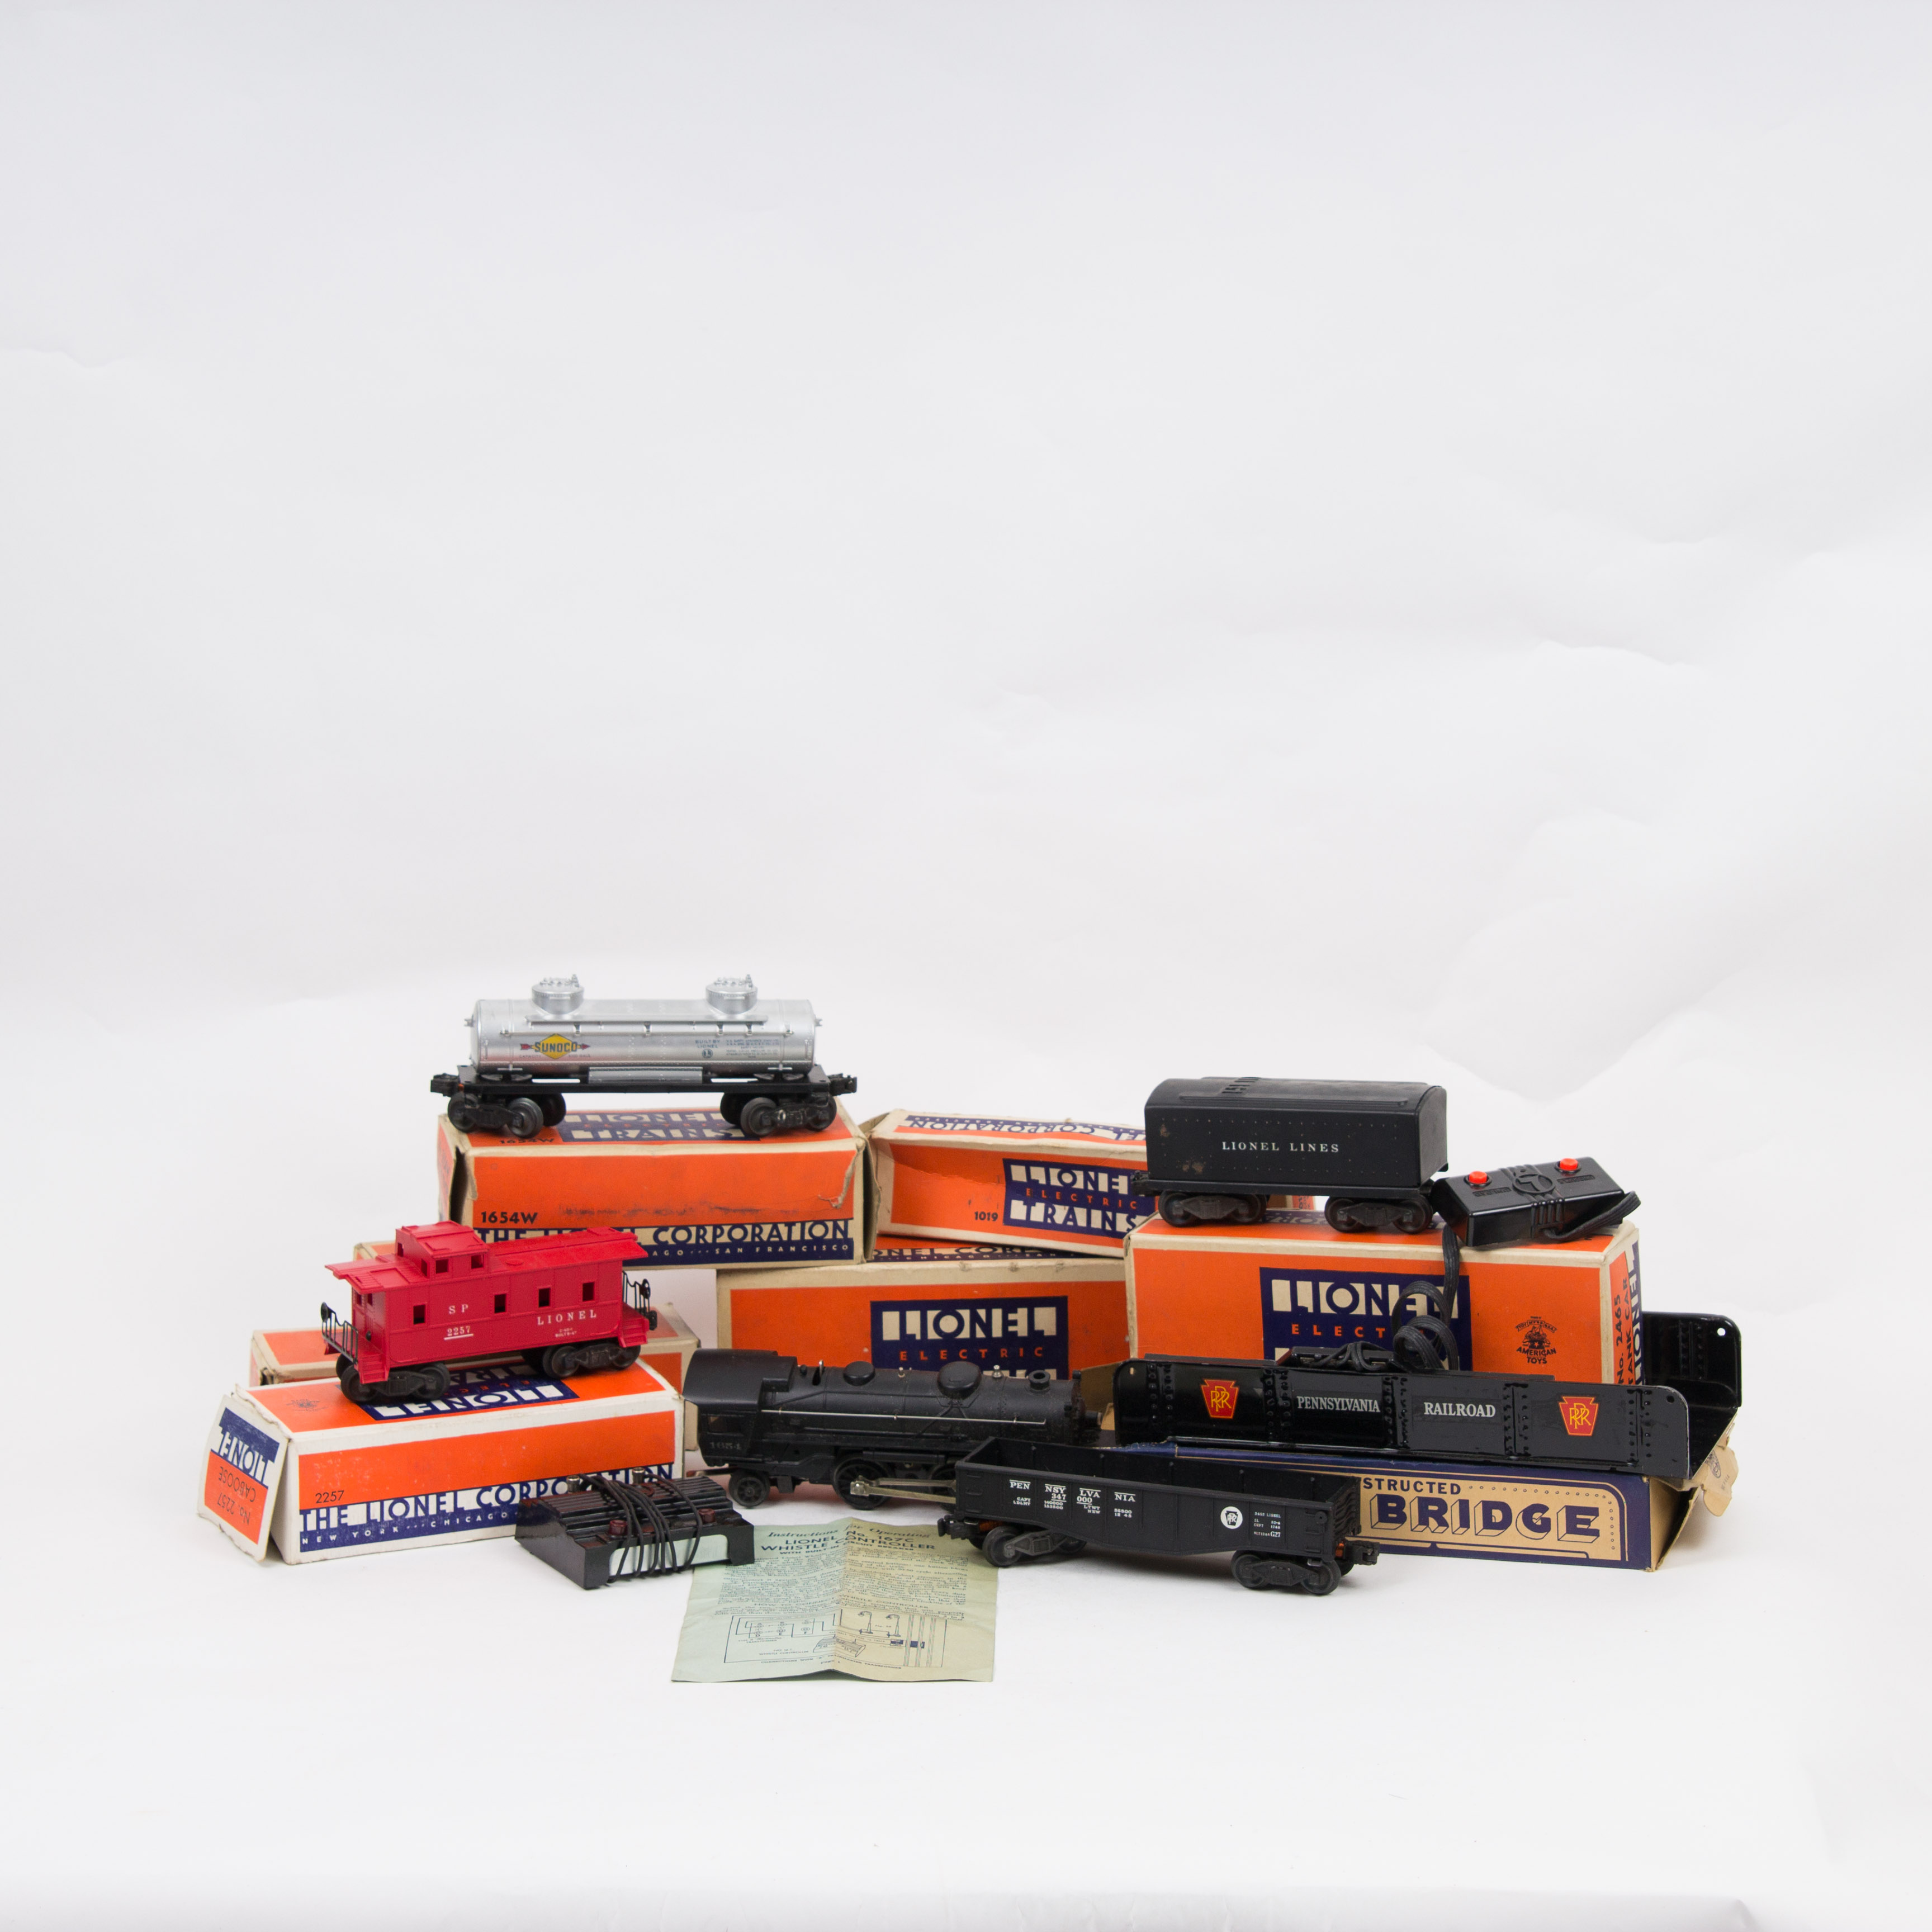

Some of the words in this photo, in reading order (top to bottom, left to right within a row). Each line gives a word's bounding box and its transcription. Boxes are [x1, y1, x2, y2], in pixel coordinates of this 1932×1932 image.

[534, 1041, 578, 1053] SUNOCO
[909, 1120, 1095, 1135] CORPORATION
[1221, 1141, 1280, 1151] LIONEL
[1289, 1142, 1339, 1153] LINES
[1026, 1187, 1137, 1210] ELECTRIC
[481, 1211, 538, 1224] 1654W
[974, 1211, 998, 1222] 1019
[1022, 1200, 1137, 1232] TRAINS
[652, 1219, 849, 1246] CORPORATION
[756, 1243, 850, 1253] FRANCISCO
[1287, 1281, 1444, 1318] LIONEL
[1622, 1276, 1631, 1320] CAR
[537, 1309, 597, 1325] LIONEL
[897, 1308, 1046, 1341] LIONEL
[1614, 1294, 1623, 1347] 2465
[447, 1325, 471, 1337] 2257
[1291, 1324, 1386, 1338] ELECT
[899, 1347, 1044, 1362] ELECTRIC
[1516, 1346, 1557, 1356] AMERICAN
[386, 1386, 546, 1415] LIONEL
[1296, 1396, 1380, 1413] PENNSYLVANIA
[1423, 1401, 1497, 1418] RAILROAD
[217, 1426, 269, 1484] LIONEL
[218, 1466, 256, 1503] CABOOSE
[1010, 1481, 1031, 1490] PEN
[1045, 1486, 1066, 1494] NSY
[1079, 1490, 1101, 1498] LVA
[1114, 1494, 1136, 1503] NIA
[217, 1492, 234, 1515] 2257
[315, 1490, 344, 1504] 2257
[300, 1507, 349, 1532] THE
[366, 1493, 465, 1523] LIONEL
[1369, 1493, 1600, 1543] BRIDGE
[302, 1534, 337, 1545] NEW
[352, 1526, 398, 1539] YORK
[430, 1512, 508, 1528] CHICAGO
[768, 1529, 839, 1537] Instructions
[869, 1528, 931, 1538] Operating
[761, 1542, 828, 1551] WHISTLE
[835, 1535, 936, 1550] CONTROLLER
[785, 1536, 837, 1545] LIONEL
